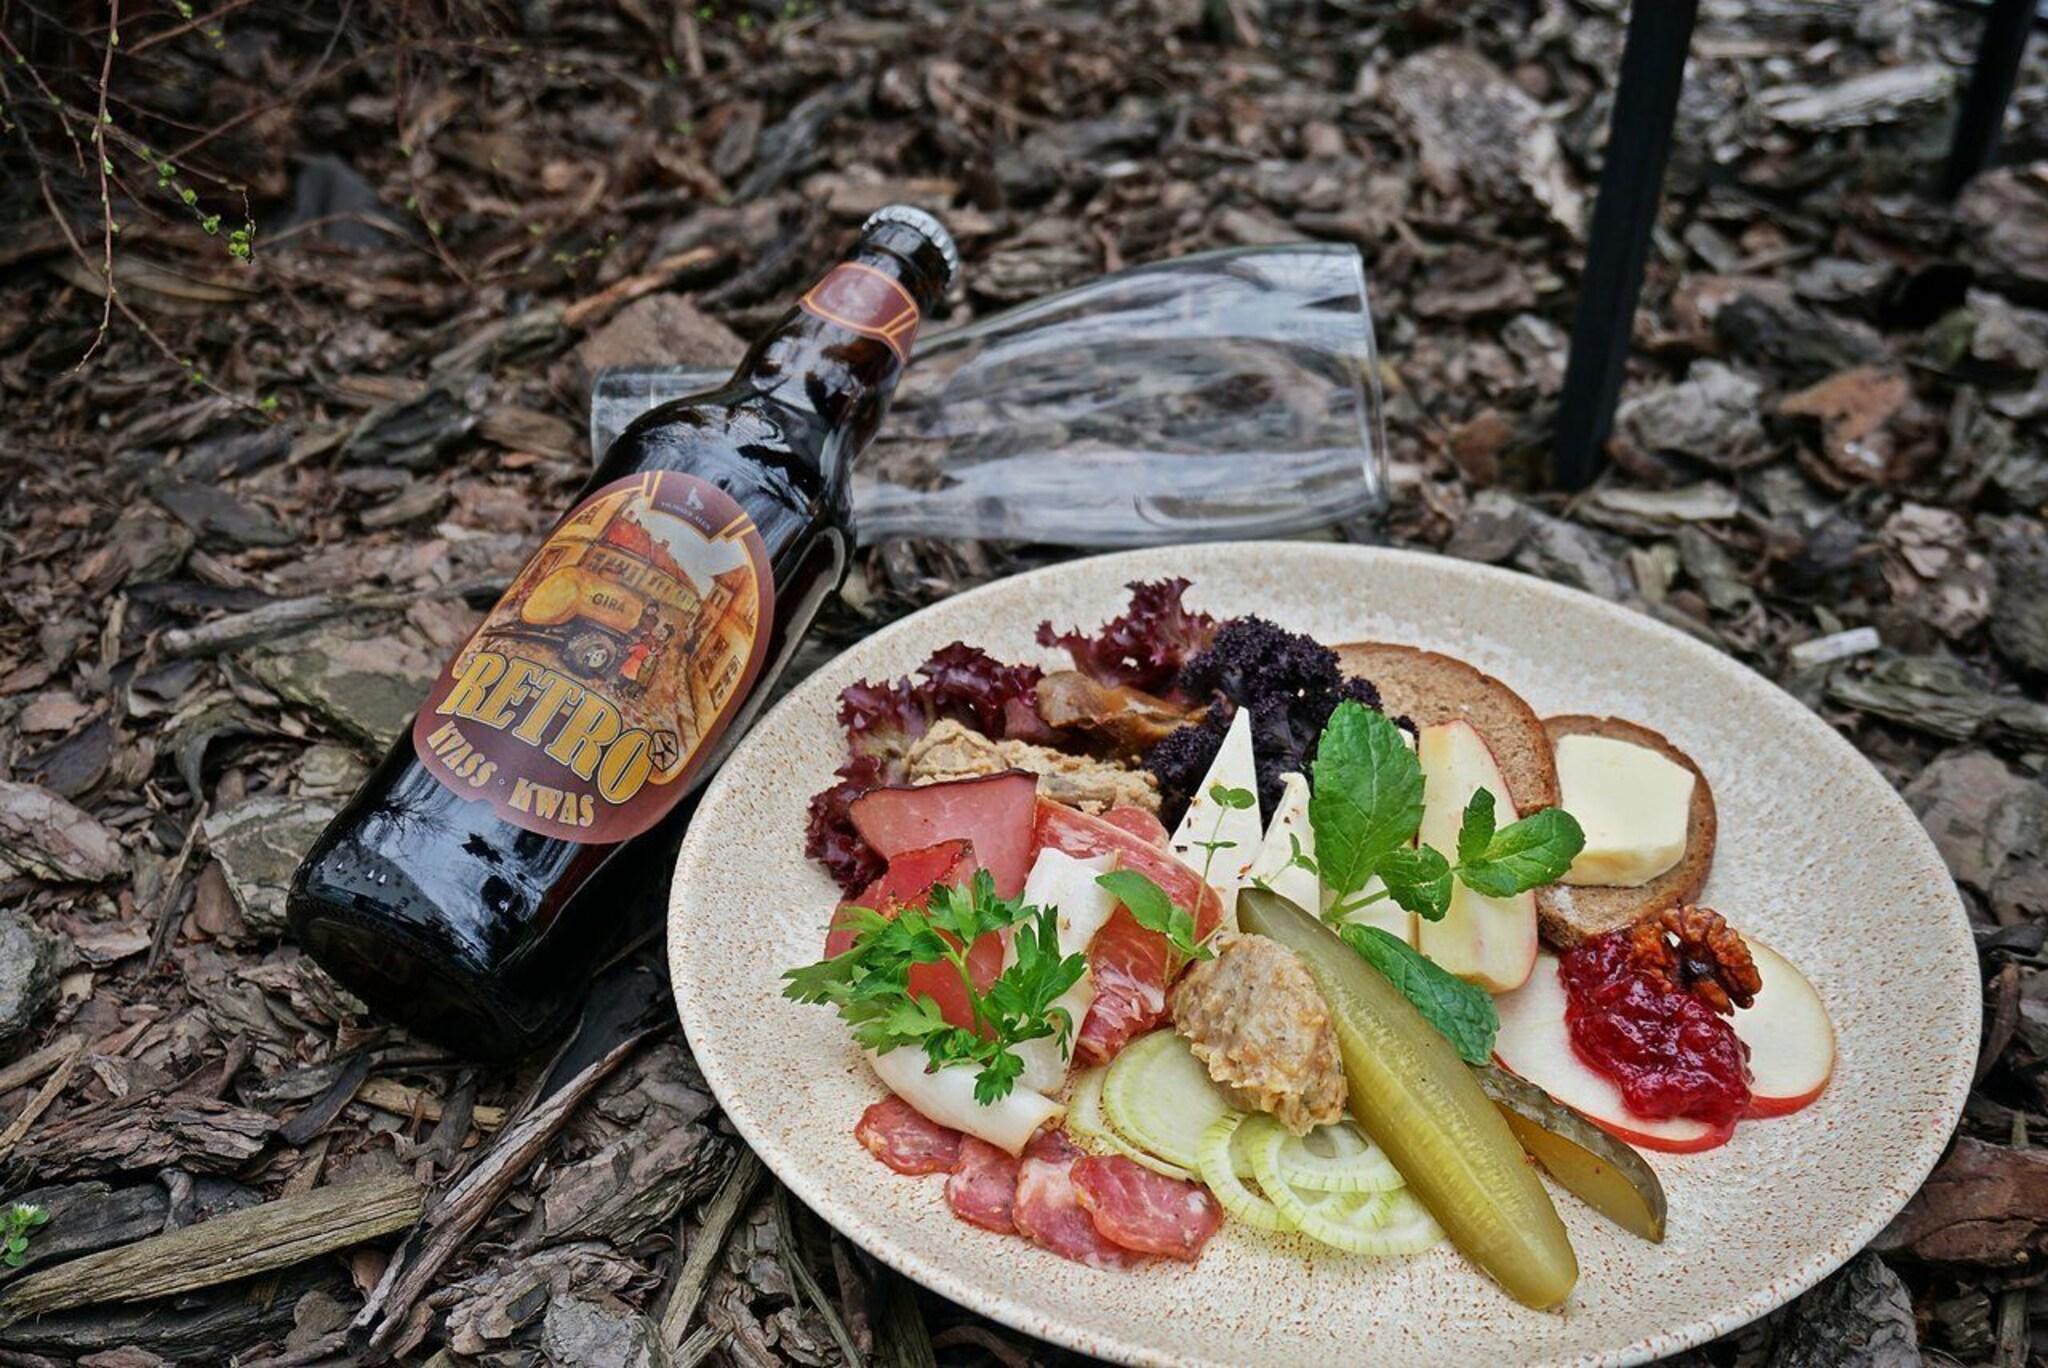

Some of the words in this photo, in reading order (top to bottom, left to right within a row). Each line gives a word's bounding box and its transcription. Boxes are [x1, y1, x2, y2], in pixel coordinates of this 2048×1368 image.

[592, 592, 625, 613] GIRA
[427, 721, 498, 787] KVASS
[508, 778, 594, 827] KWAS
[436, 652, 653, 804] RETRO
